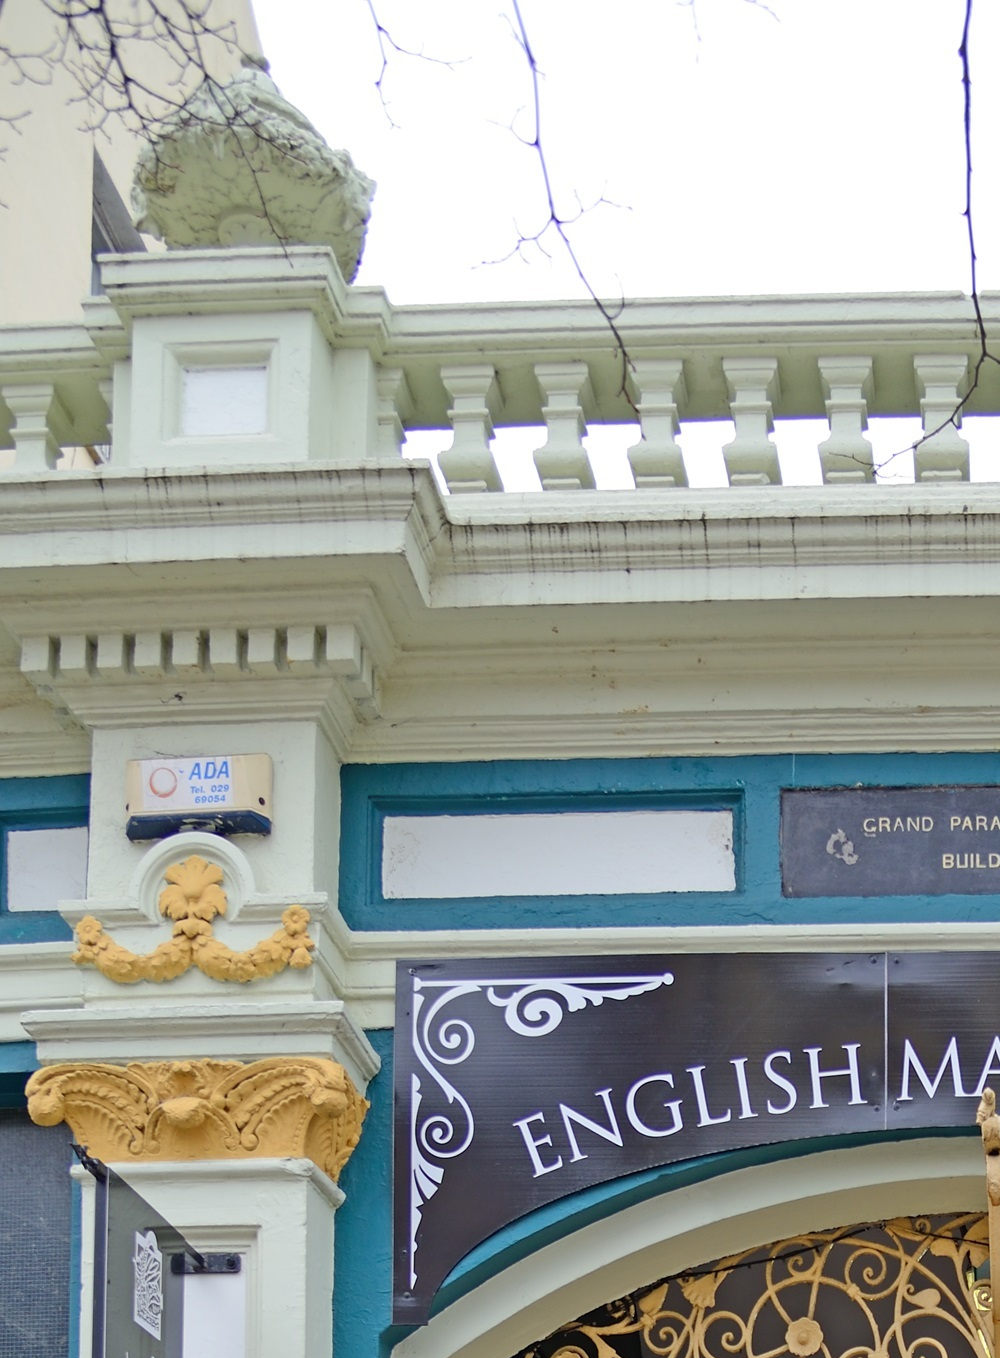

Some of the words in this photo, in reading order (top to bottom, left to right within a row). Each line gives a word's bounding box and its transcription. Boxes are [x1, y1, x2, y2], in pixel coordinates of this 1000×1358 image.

[188, 761, 230, 780] ADA
[190, 786, 205, 794] Tel.
[210, 784, 230, 793] 029
[194, 794, 226, 803] 69054
[863, 816, 934, 834] GRAND
[512, 1043, 868, 1178] ENGLISH
